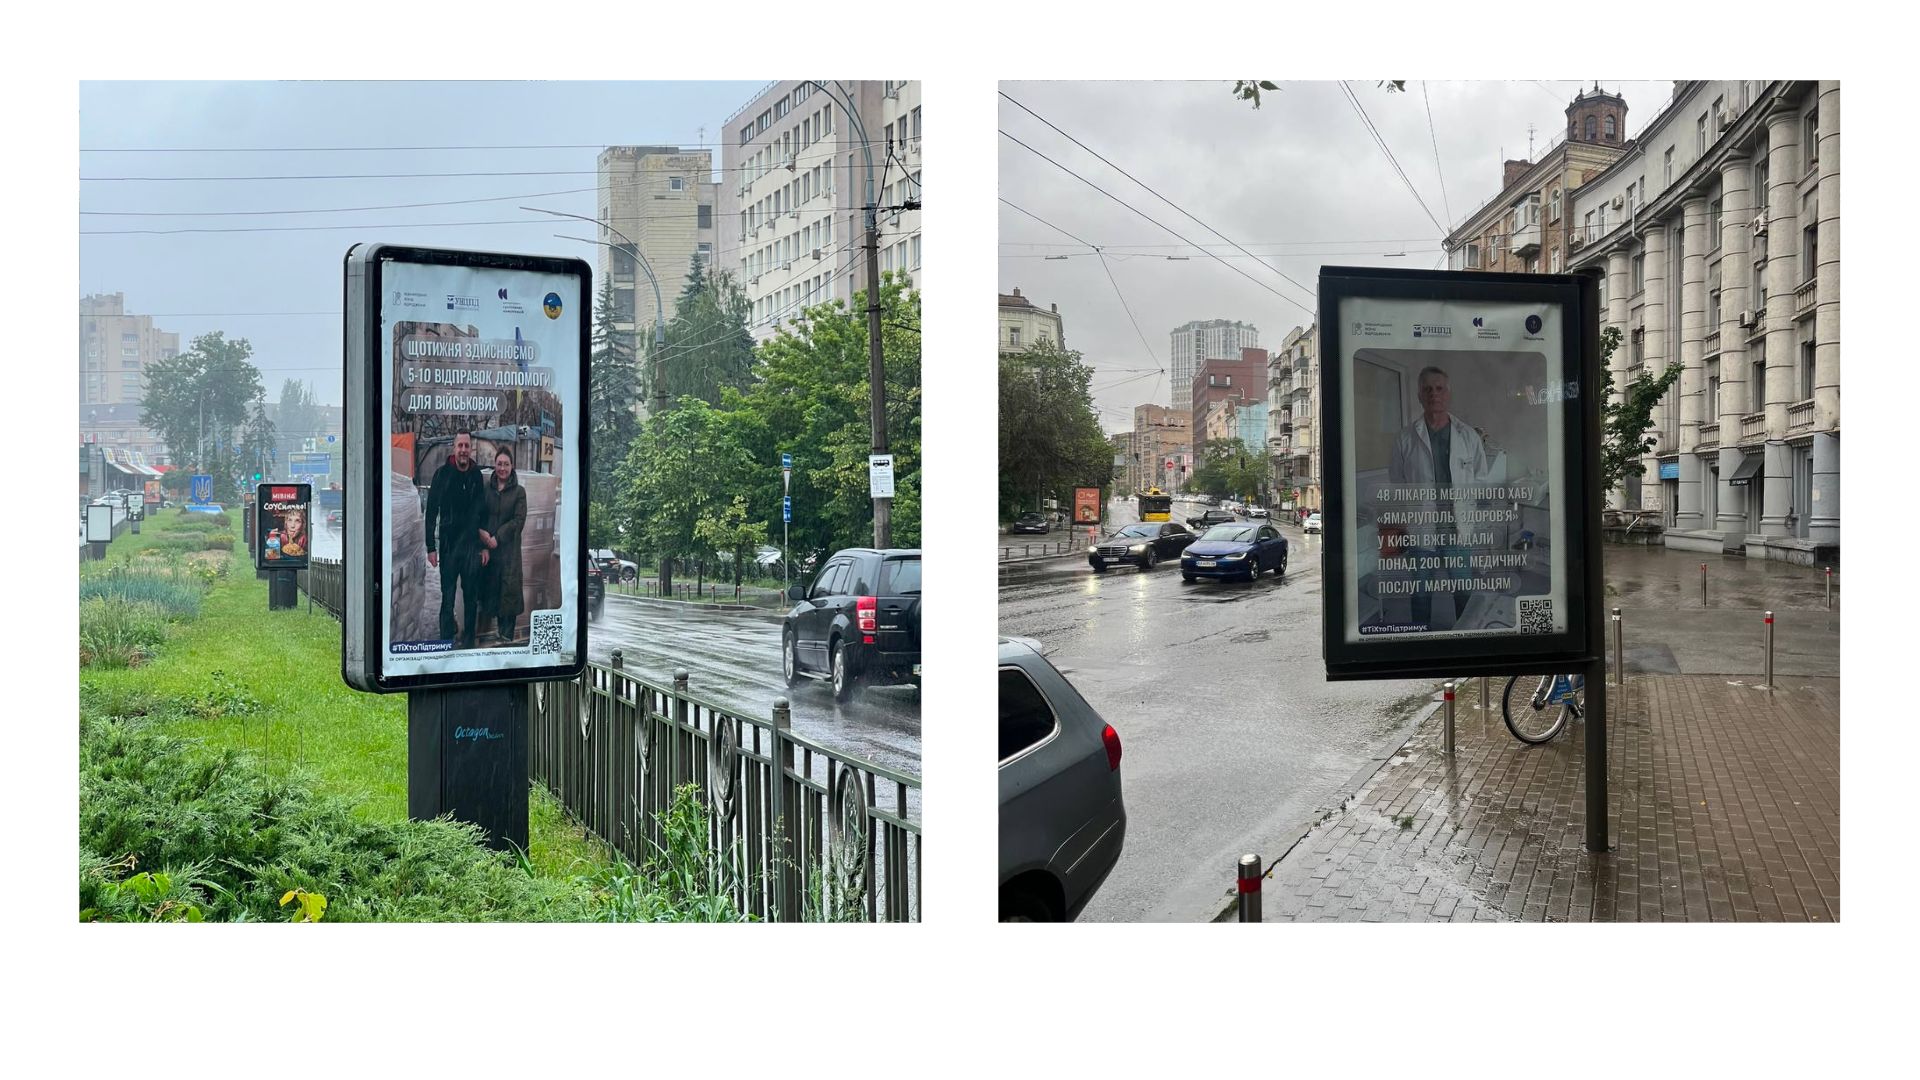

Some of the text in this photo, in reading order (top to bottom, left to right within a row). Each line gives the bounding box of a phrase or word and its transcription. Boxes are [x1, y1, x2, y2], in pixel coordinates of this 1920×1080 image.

[408, 340, 534, 360] ЩОТИЖНЯ ЗДІЙСНЮЄМО
[408, 367, 551, 387] 5-10 ВІДПРАВОК ДОПОМОГИ
[408, 391, 499, 412] ДЛЯ ВІЙСЬКОВИХ
[1376, 486, 1534, 502] 48 ЛІКАРІВ МЕДИЧНОГО ХАБУ
[1377, 532, 1494, 549] У КИЄВІ ВЖЕ НАДАЛИ
[1378, 553, 1528, 572] ПОНАД 200 ТИС. МЕДИЧНИХ
[1378, 577, 1511, 595] ПОСЛУГ МАРІУПОЛЬЦЯМ
[1362, 624, 1428, 634] #ТіХтоПідтримує
[392, 642, 453, 652] #ТіХтоПідтримує
[455, 726, 489, 741] Octagon
